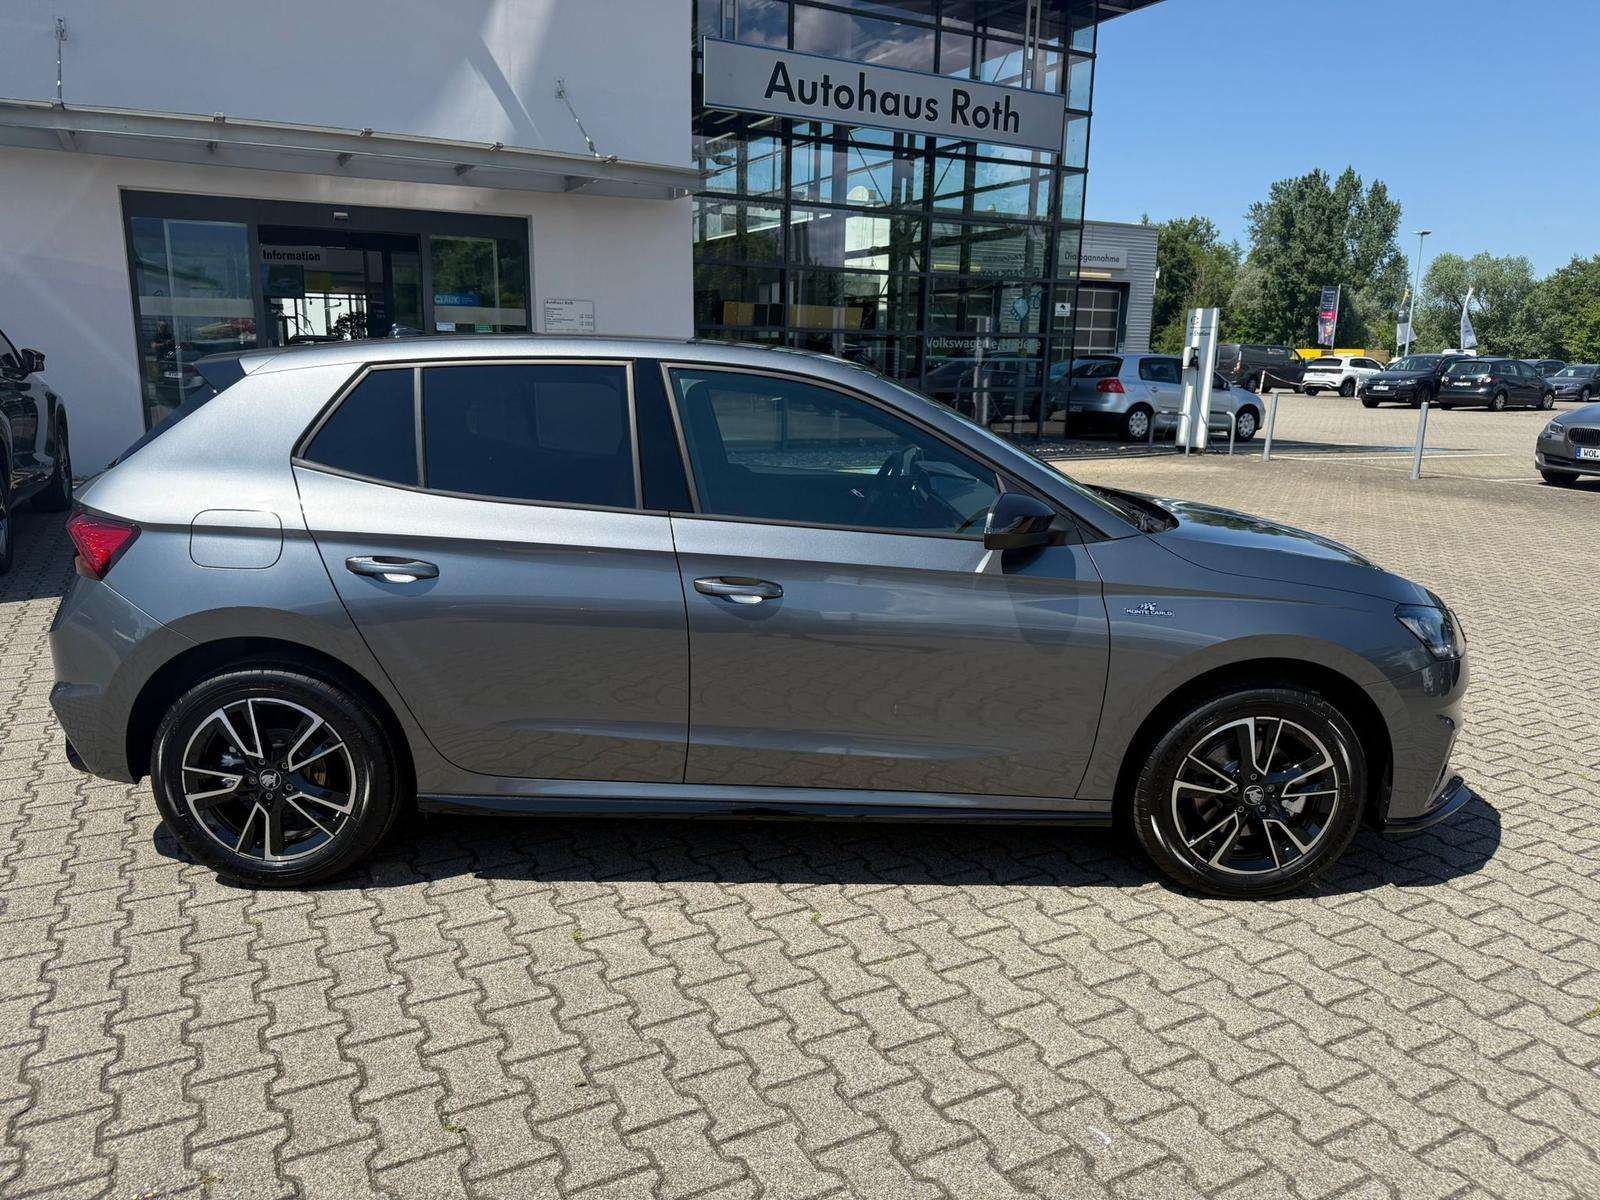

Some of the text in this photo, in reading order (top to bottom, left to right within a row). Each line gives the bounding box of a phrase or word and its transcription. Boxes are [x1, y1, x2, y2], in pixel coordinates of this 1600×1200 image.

[764, 60, 1020, 133] Autohaus Roth
[263, 249, 321, 261] Information
[1064, 250, 1120, 264] Diaogannahme
